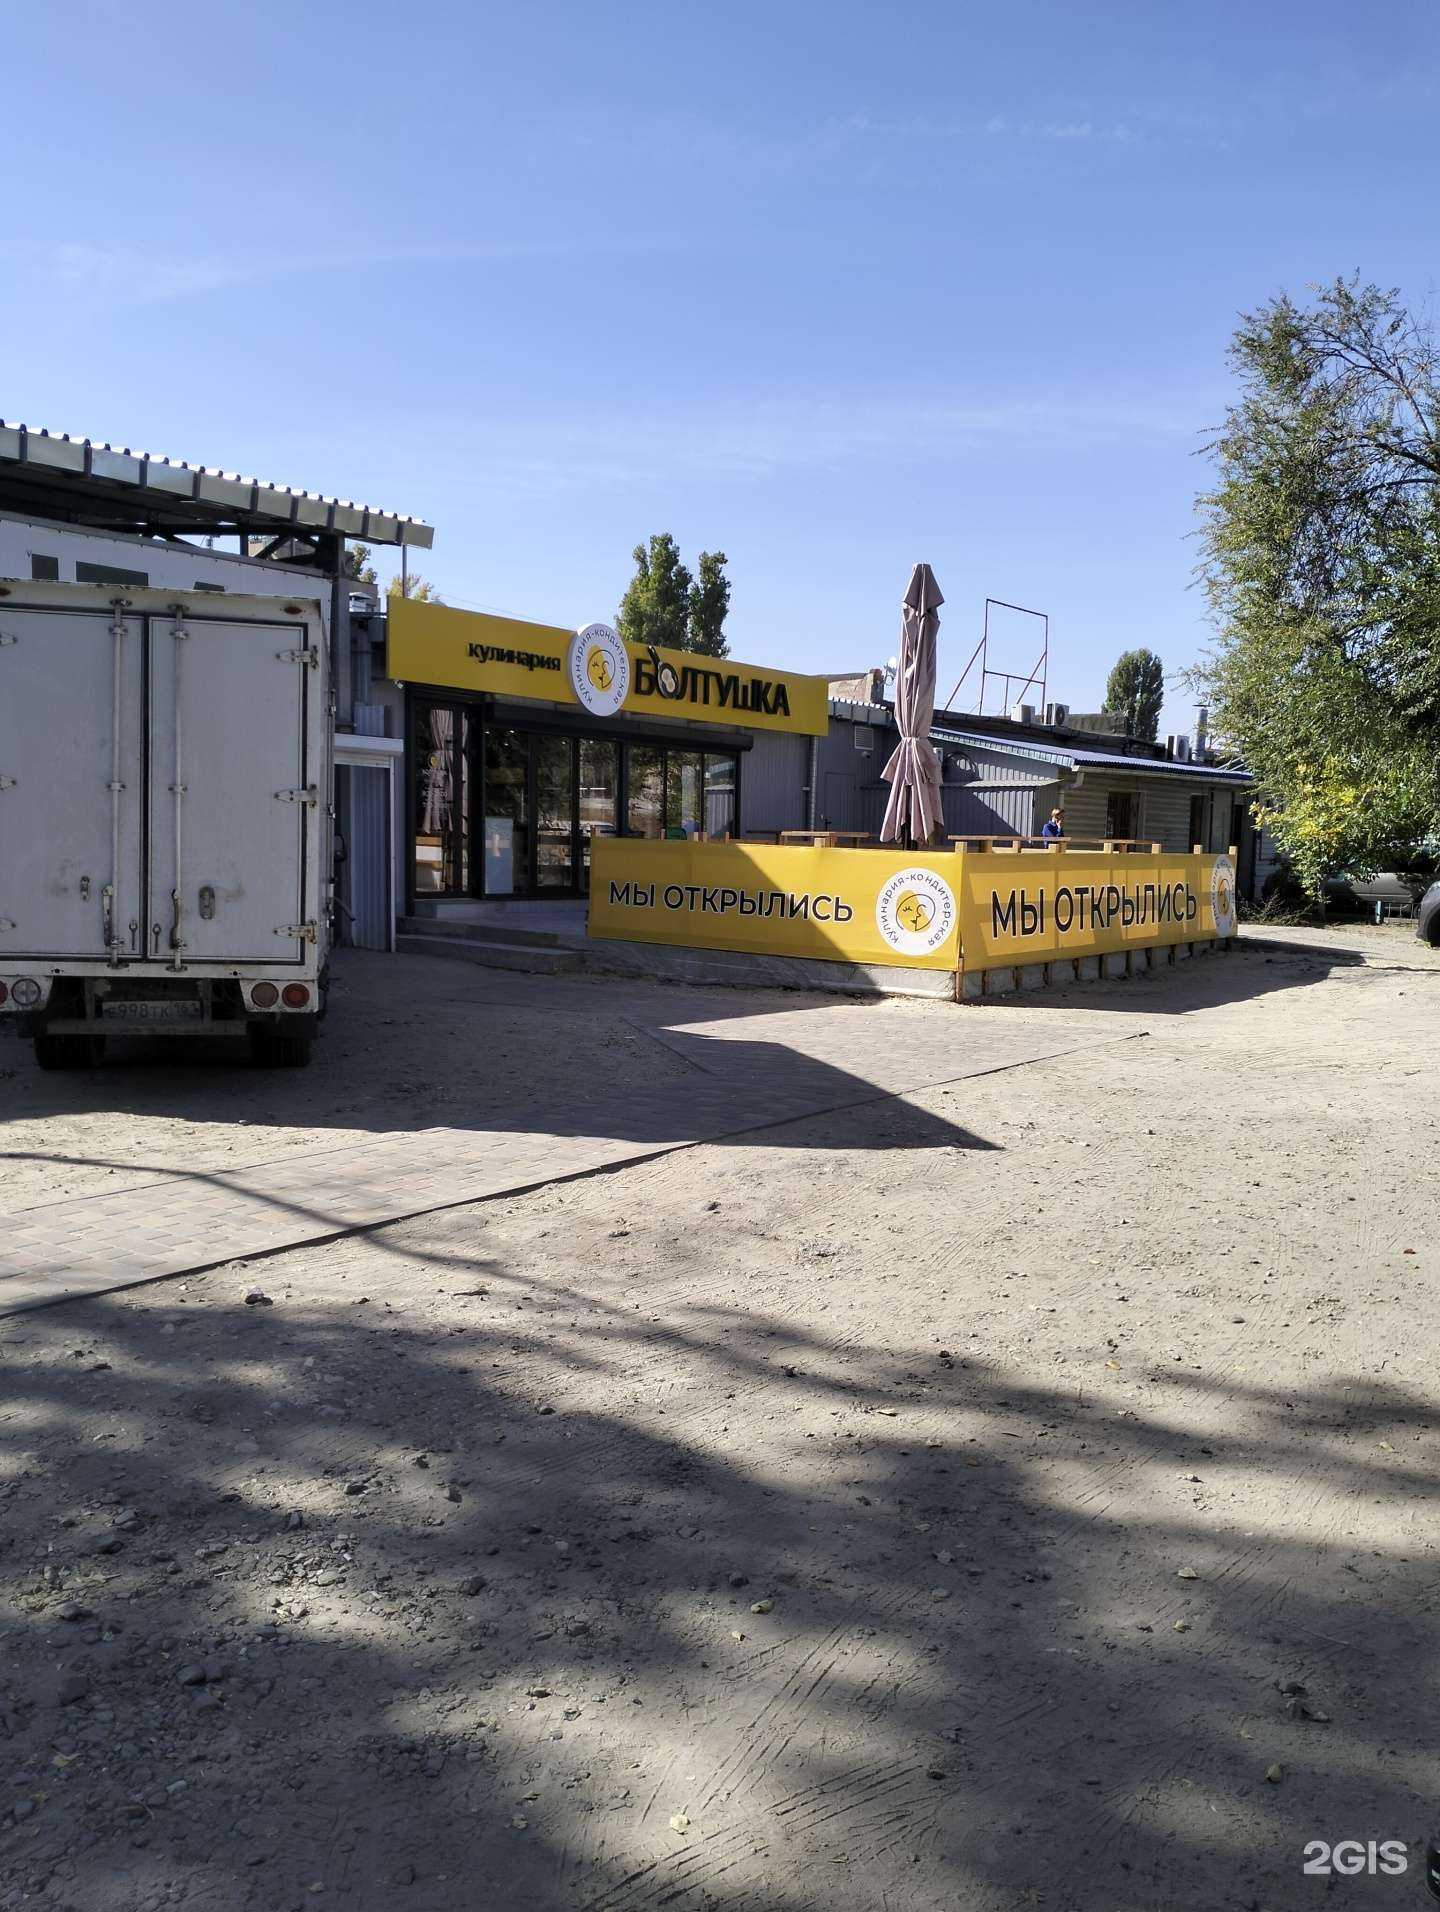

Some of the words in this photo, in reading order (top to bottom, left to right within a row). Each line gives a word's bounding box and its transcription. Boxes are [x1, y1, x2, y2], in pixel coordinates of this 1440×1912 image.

[468, 642, 561, 671] кулинария
[635, 650, 791, 716] БОЛТУШКА
[610, 881, 655, 907] МЫ
[664, 885, 853, 922] ОТКРЫЛИСЬ
[992, 888, 1045, 939] МЫ
[1054, 883, 1197, 932] ОТКРЫЛИСЬ
